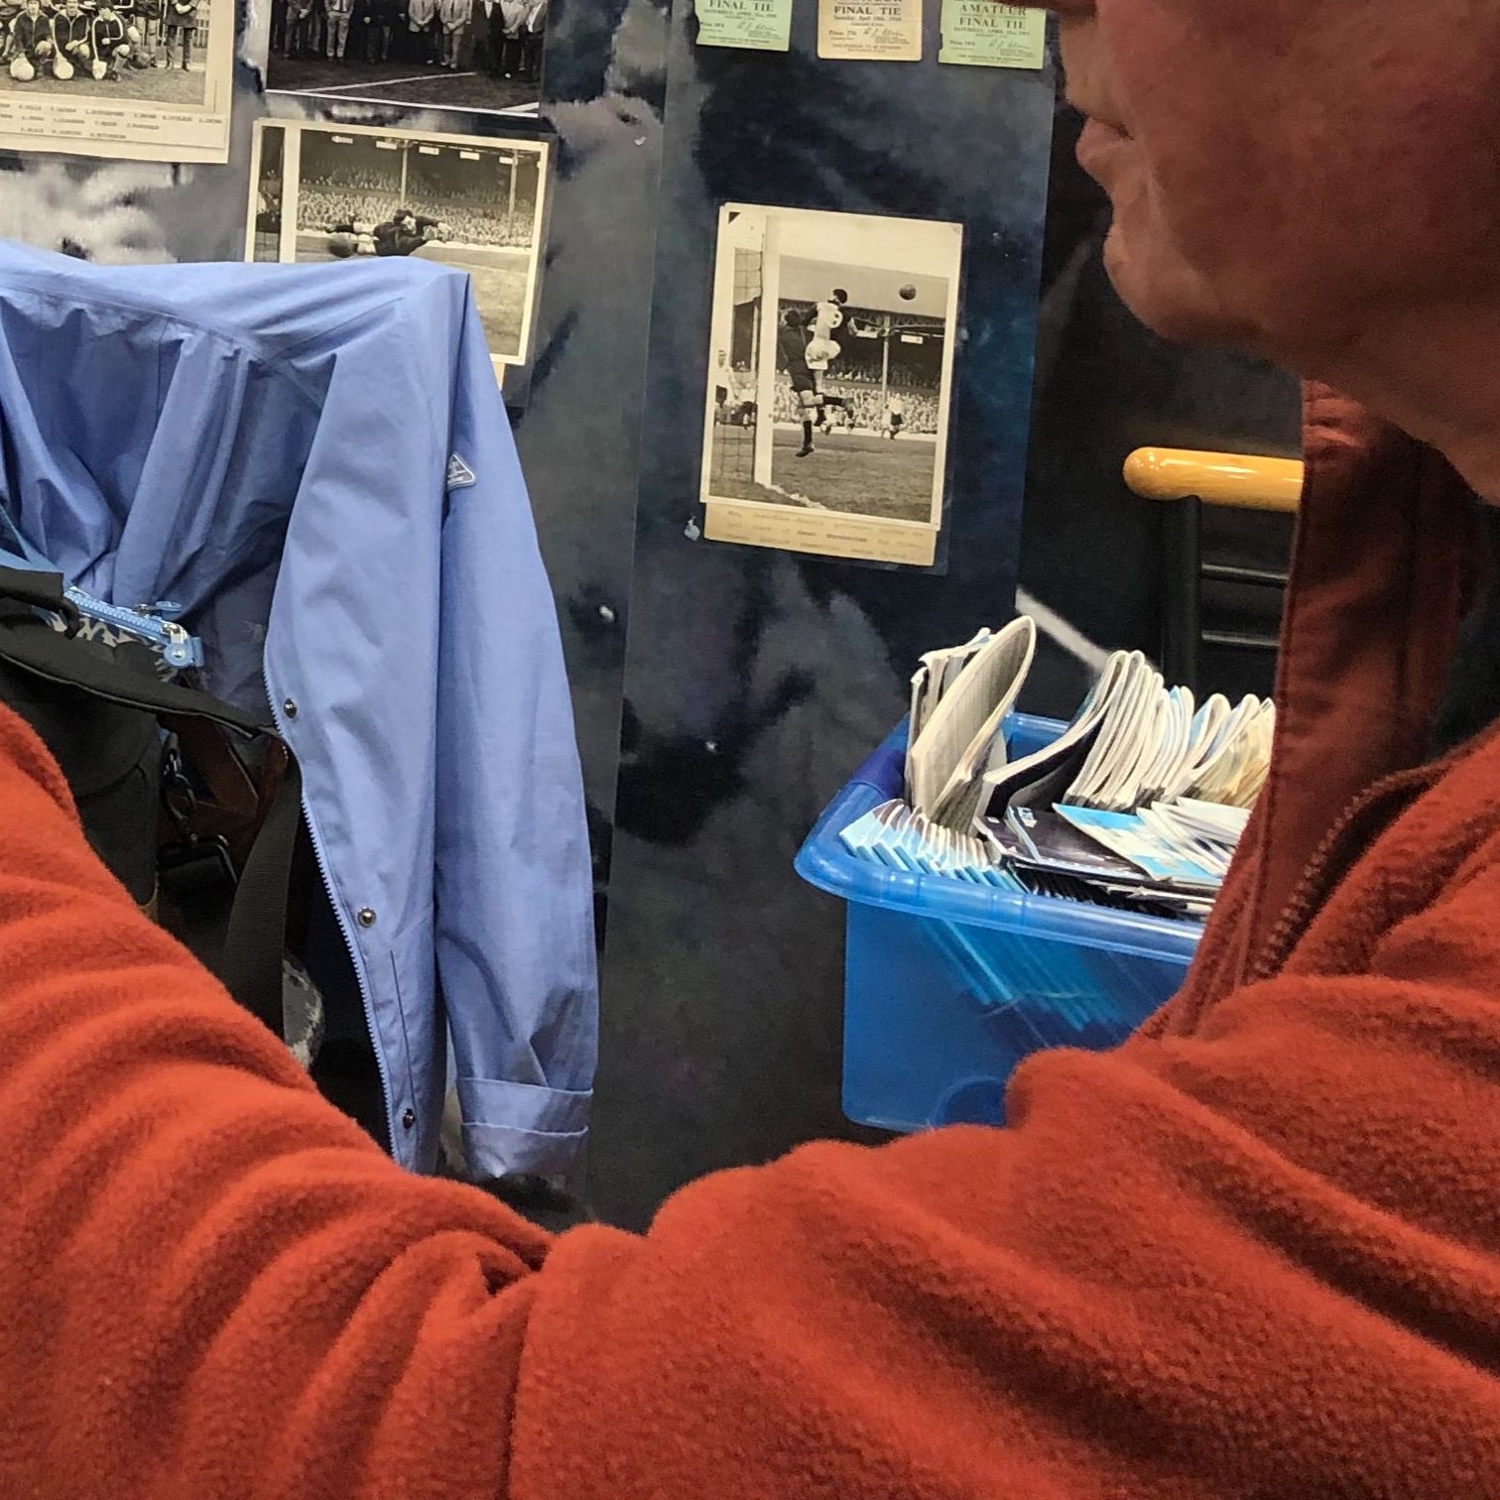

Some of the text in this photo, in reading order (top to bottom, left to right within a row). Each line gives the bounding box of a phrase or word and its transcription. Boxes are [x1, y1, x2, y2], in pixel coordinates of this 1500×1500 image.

[709, 0, 774, 12] FINAL TIE
[834, 6, 902, 16] FINAL TIE
[961, 4, 1026, 16] AMATEUR
[960, 17, 1026, 29] FINAL TIE
